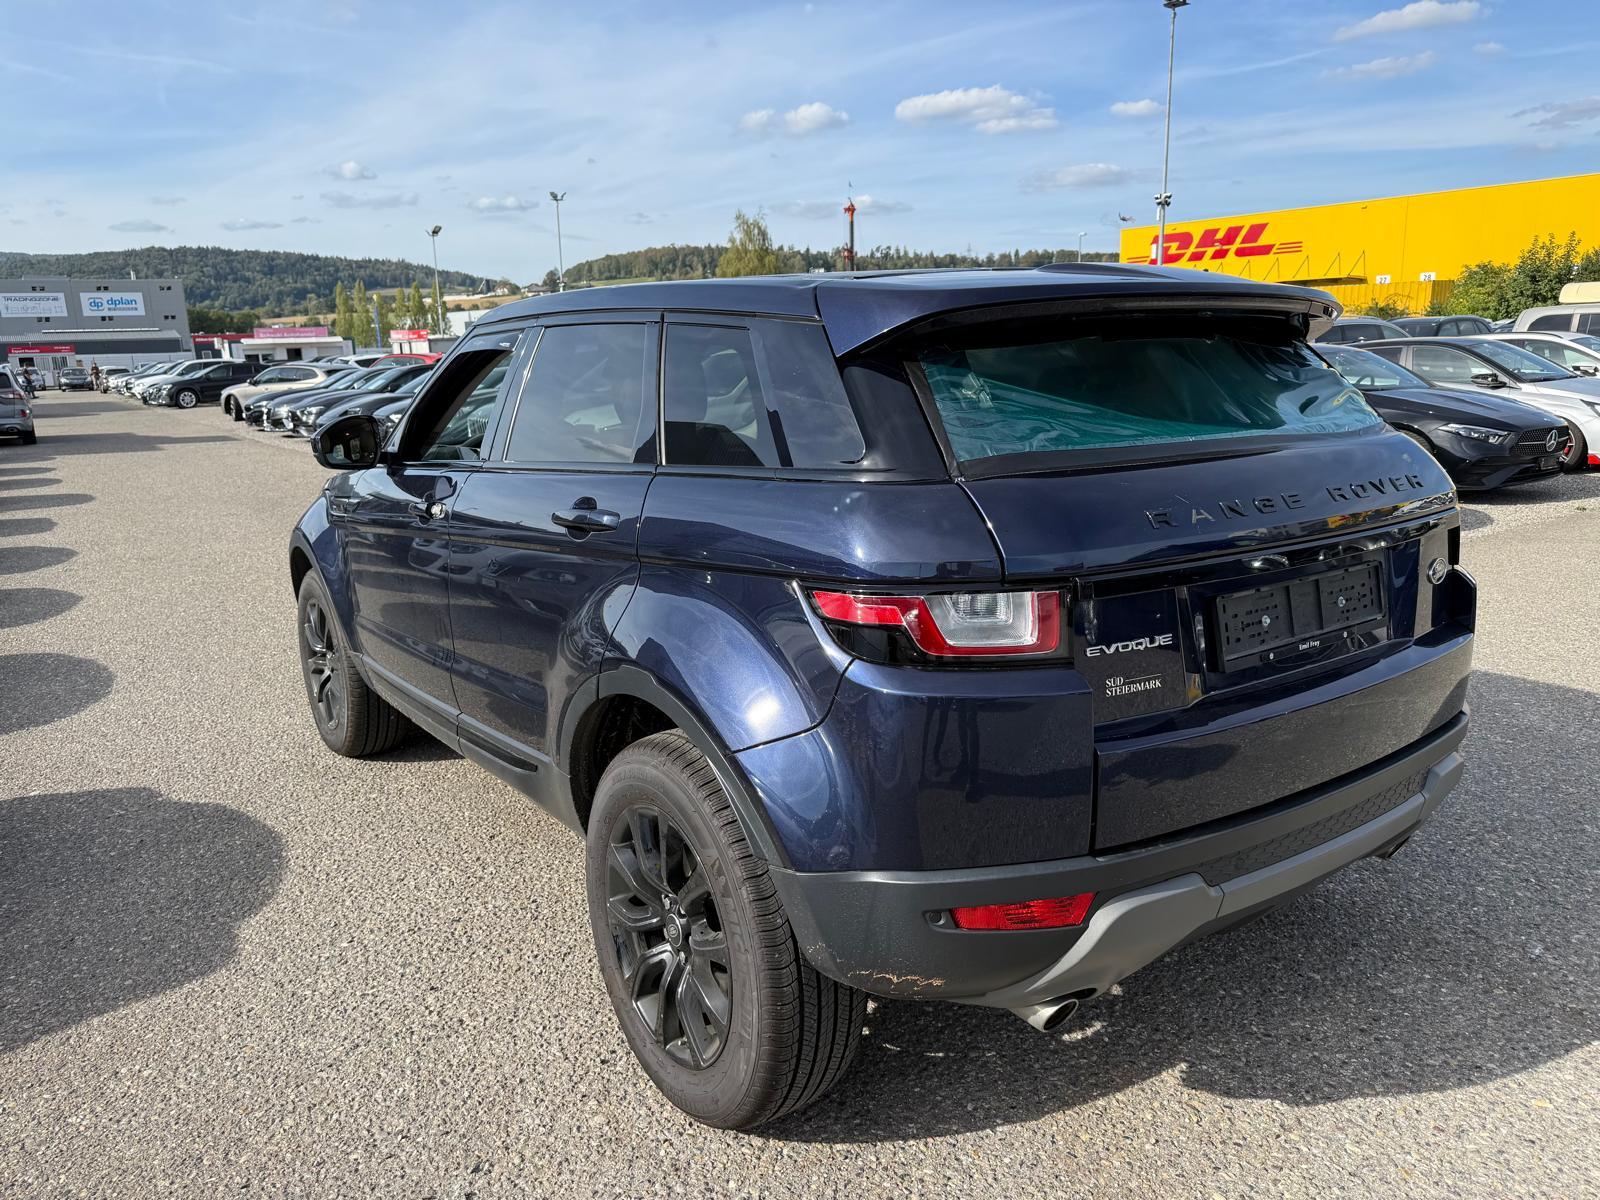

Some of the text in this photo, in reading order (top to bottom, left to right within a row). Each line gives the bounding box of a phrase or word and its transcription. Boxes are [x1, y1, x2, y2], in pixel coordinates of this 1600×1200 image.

[1148, 222, 1275, 265] DHL
[106, 296, 138, 307] dplan
[1144, 473, 1424, 529] RANGE ROVER
[1086, 633, 1173, 657] EVOQUE
[1299, 641, 1309, 650] Emil
[1105, 678, 1162, 698] STEIERMARK
